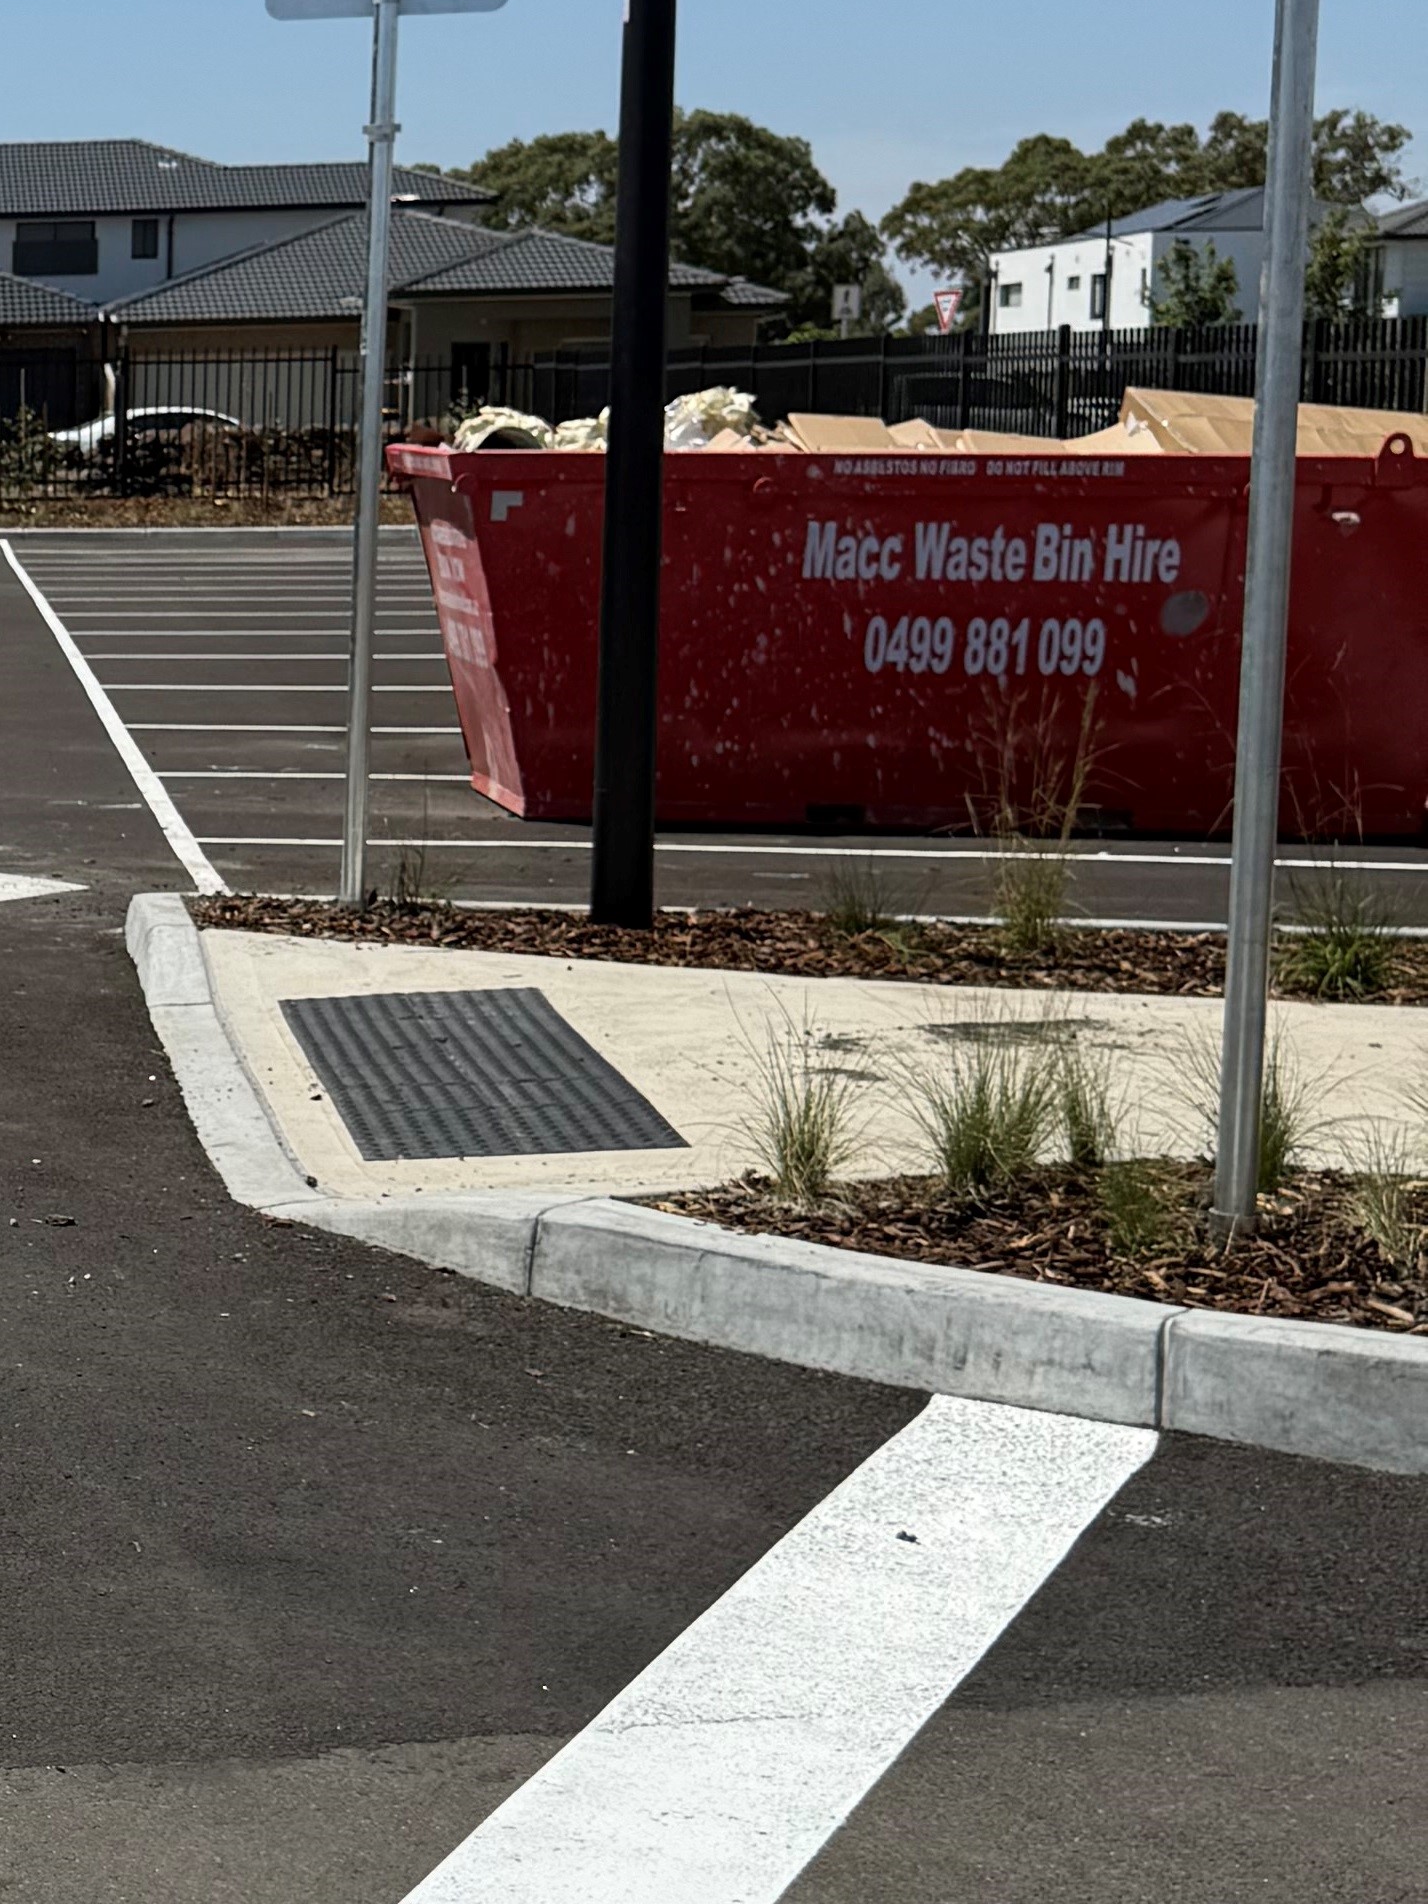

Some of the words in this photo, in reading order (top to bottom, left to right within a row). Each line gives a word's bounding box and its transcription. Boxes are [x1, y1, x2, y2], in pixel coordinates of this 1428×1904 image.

[834, 459, 852, 475] NO
[853, 459, 917, 475] ASBESTOS
[919, 459, 937, 475] NO
[1005, 460, 1030, 476] NOT
[1031, 460, 1057, 476] FILL
[1058, 460, 1100, 476] ABOVE
[1101, 460, 1124, 477] RIM
[802, 521, 902, 581] Macc
[915, 522, 1026, 581] Waste
[1032, 522, 1094, 582] Bin
[1103, 523, 1181, 583] Hire
[864, 616, 955, 674] 0499
[964, 617, 1030, 676] 881
[1038, 617, 1106, 676] 099
